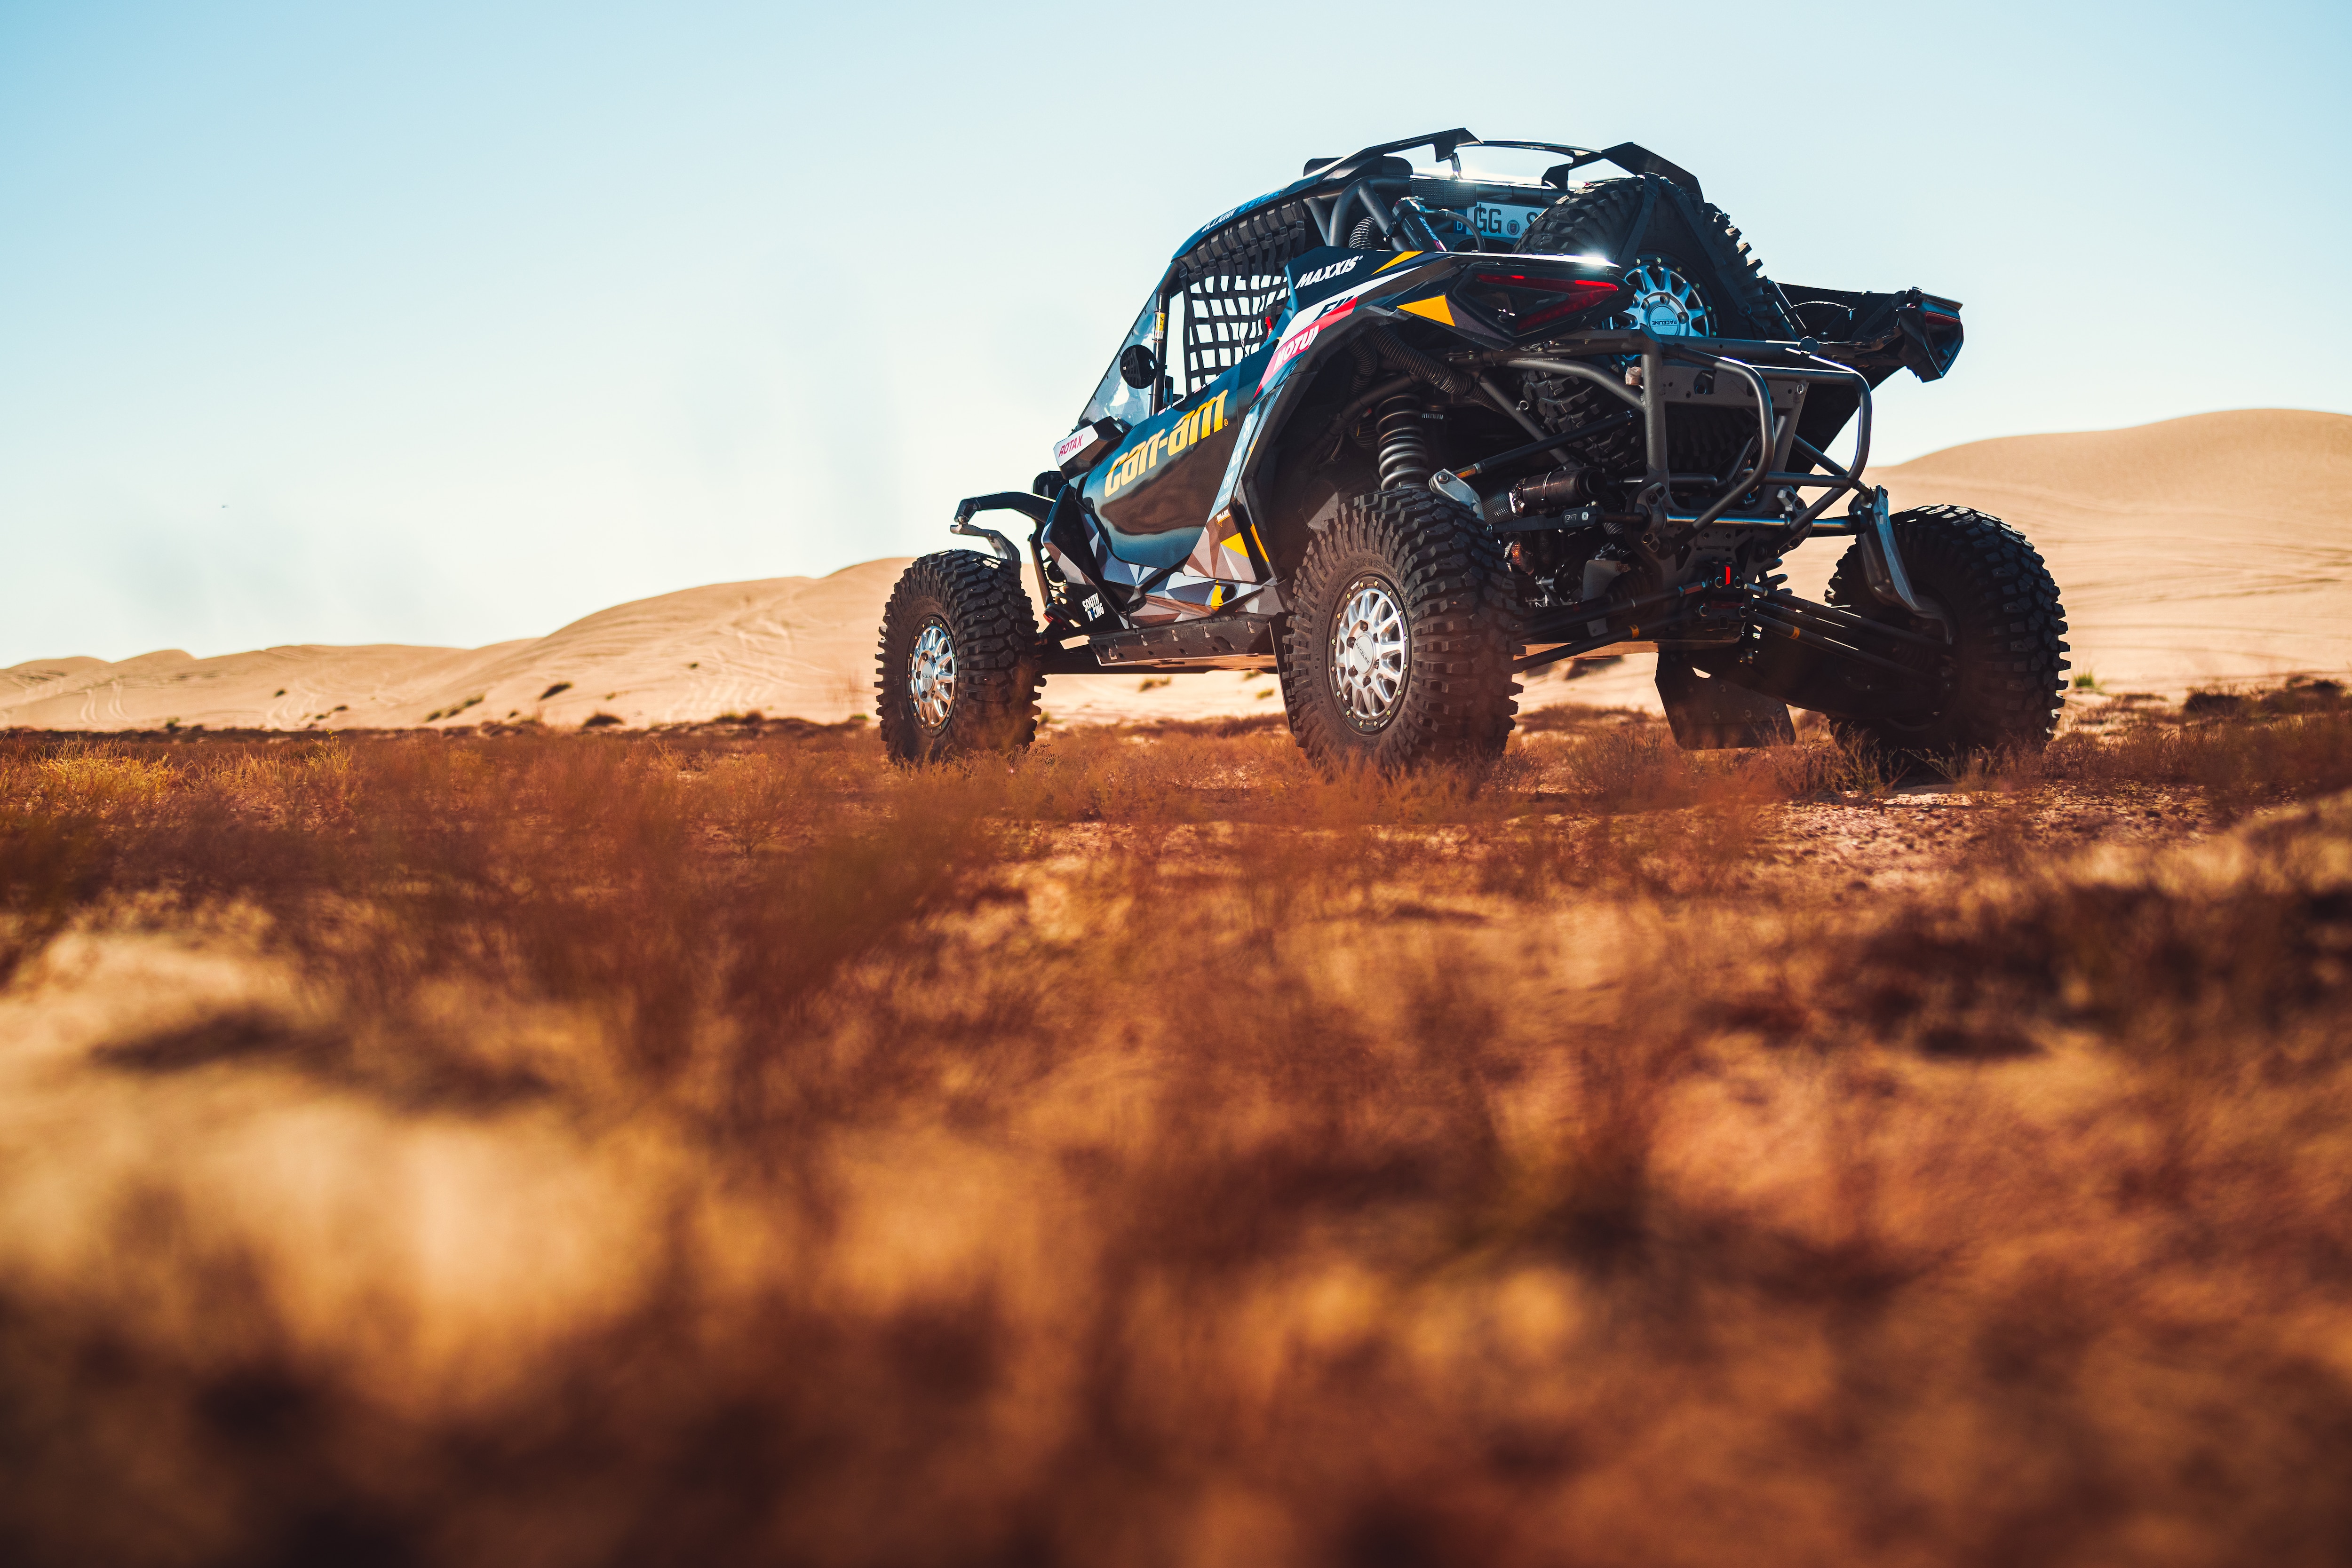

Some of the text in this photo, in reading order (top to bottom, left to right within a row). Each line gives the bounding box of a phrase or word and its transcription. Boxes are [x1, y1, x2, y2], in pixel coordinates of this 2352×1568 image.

[1473, 206, 1502, 234] GG
[1294, 255, 1360, 290] MAXXIS
[1058, 434, 1083, 458] ROTAX
[1082, 592, 1100, 612] SOUTH
[1355, 642, 1370, 665] RACELINE
